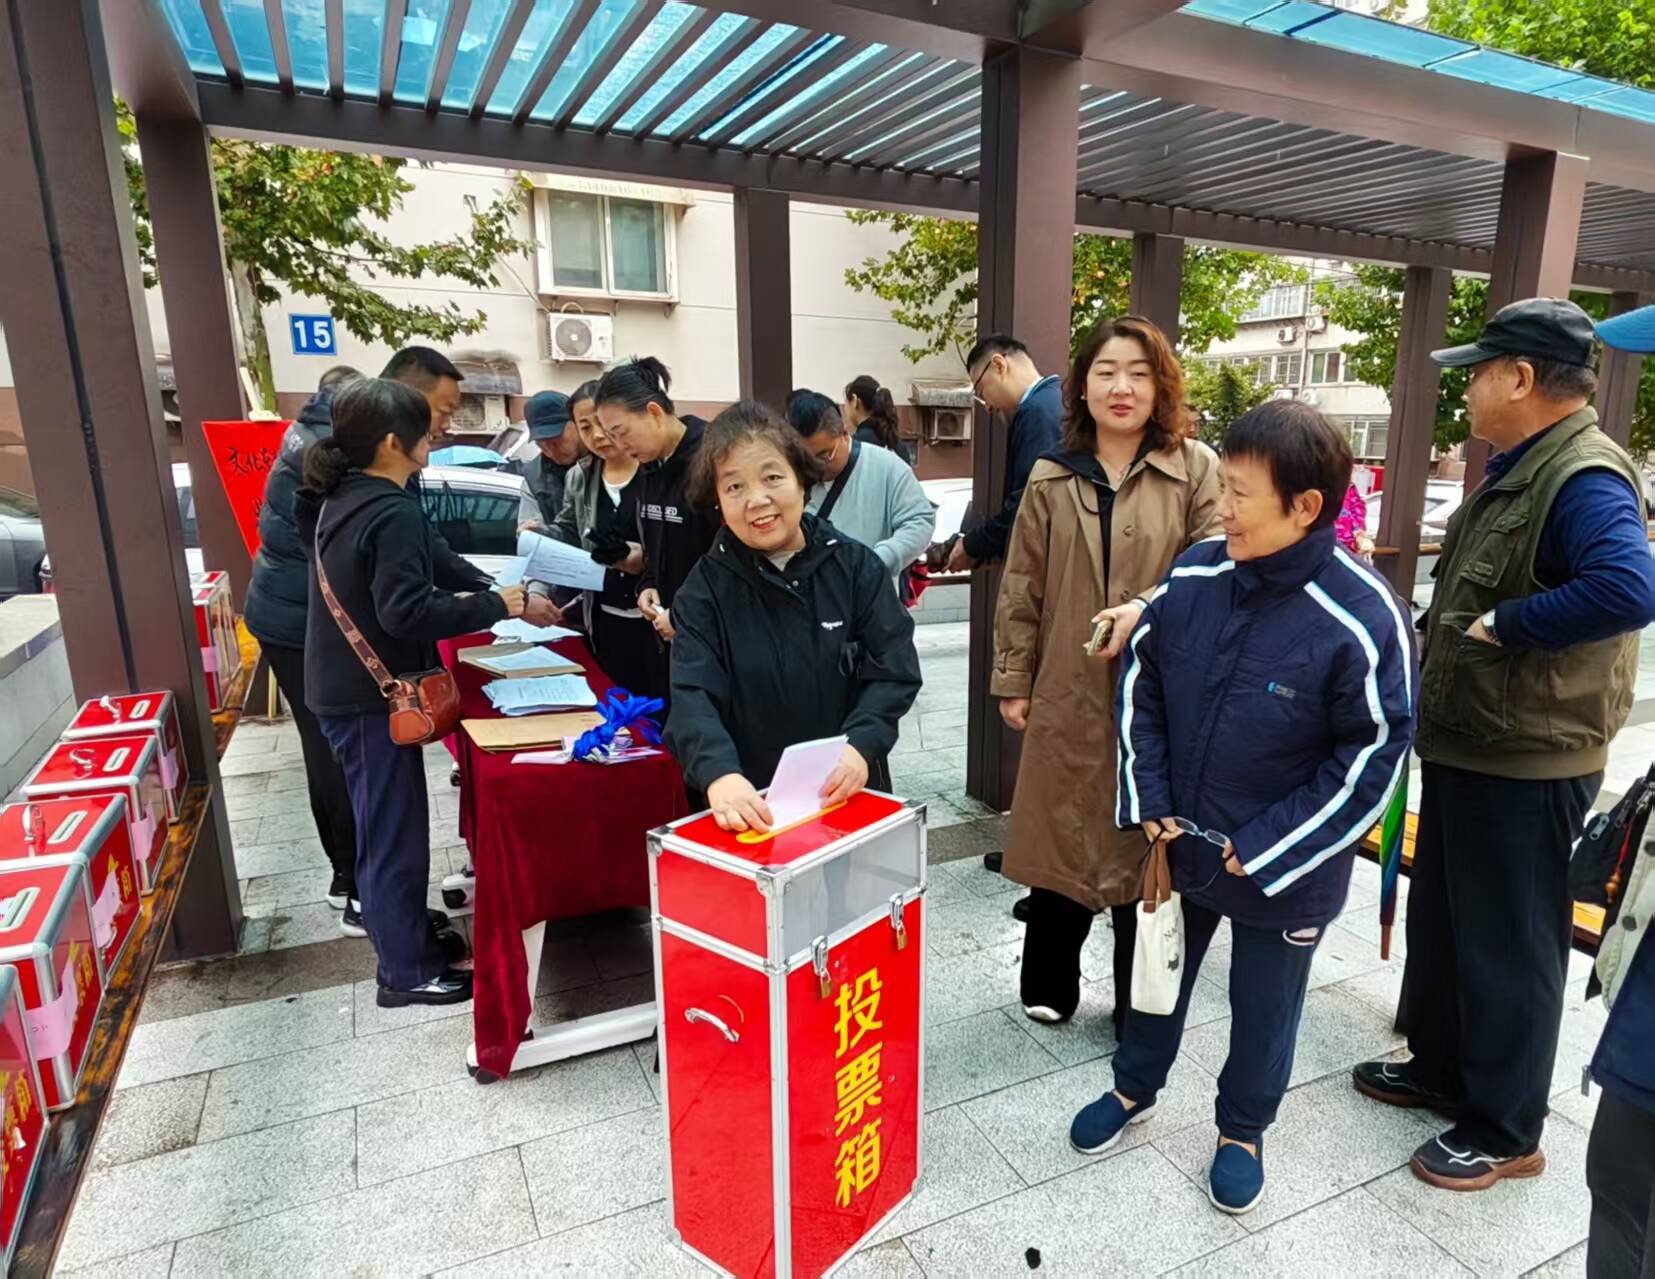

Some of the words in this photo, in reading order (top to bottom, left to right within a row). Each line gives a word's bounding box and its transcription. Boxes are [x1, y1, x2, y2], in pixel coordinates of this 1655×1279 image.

[294, 320, 331, 349] 15
[834, 967, 882, 1208] 投票箱
